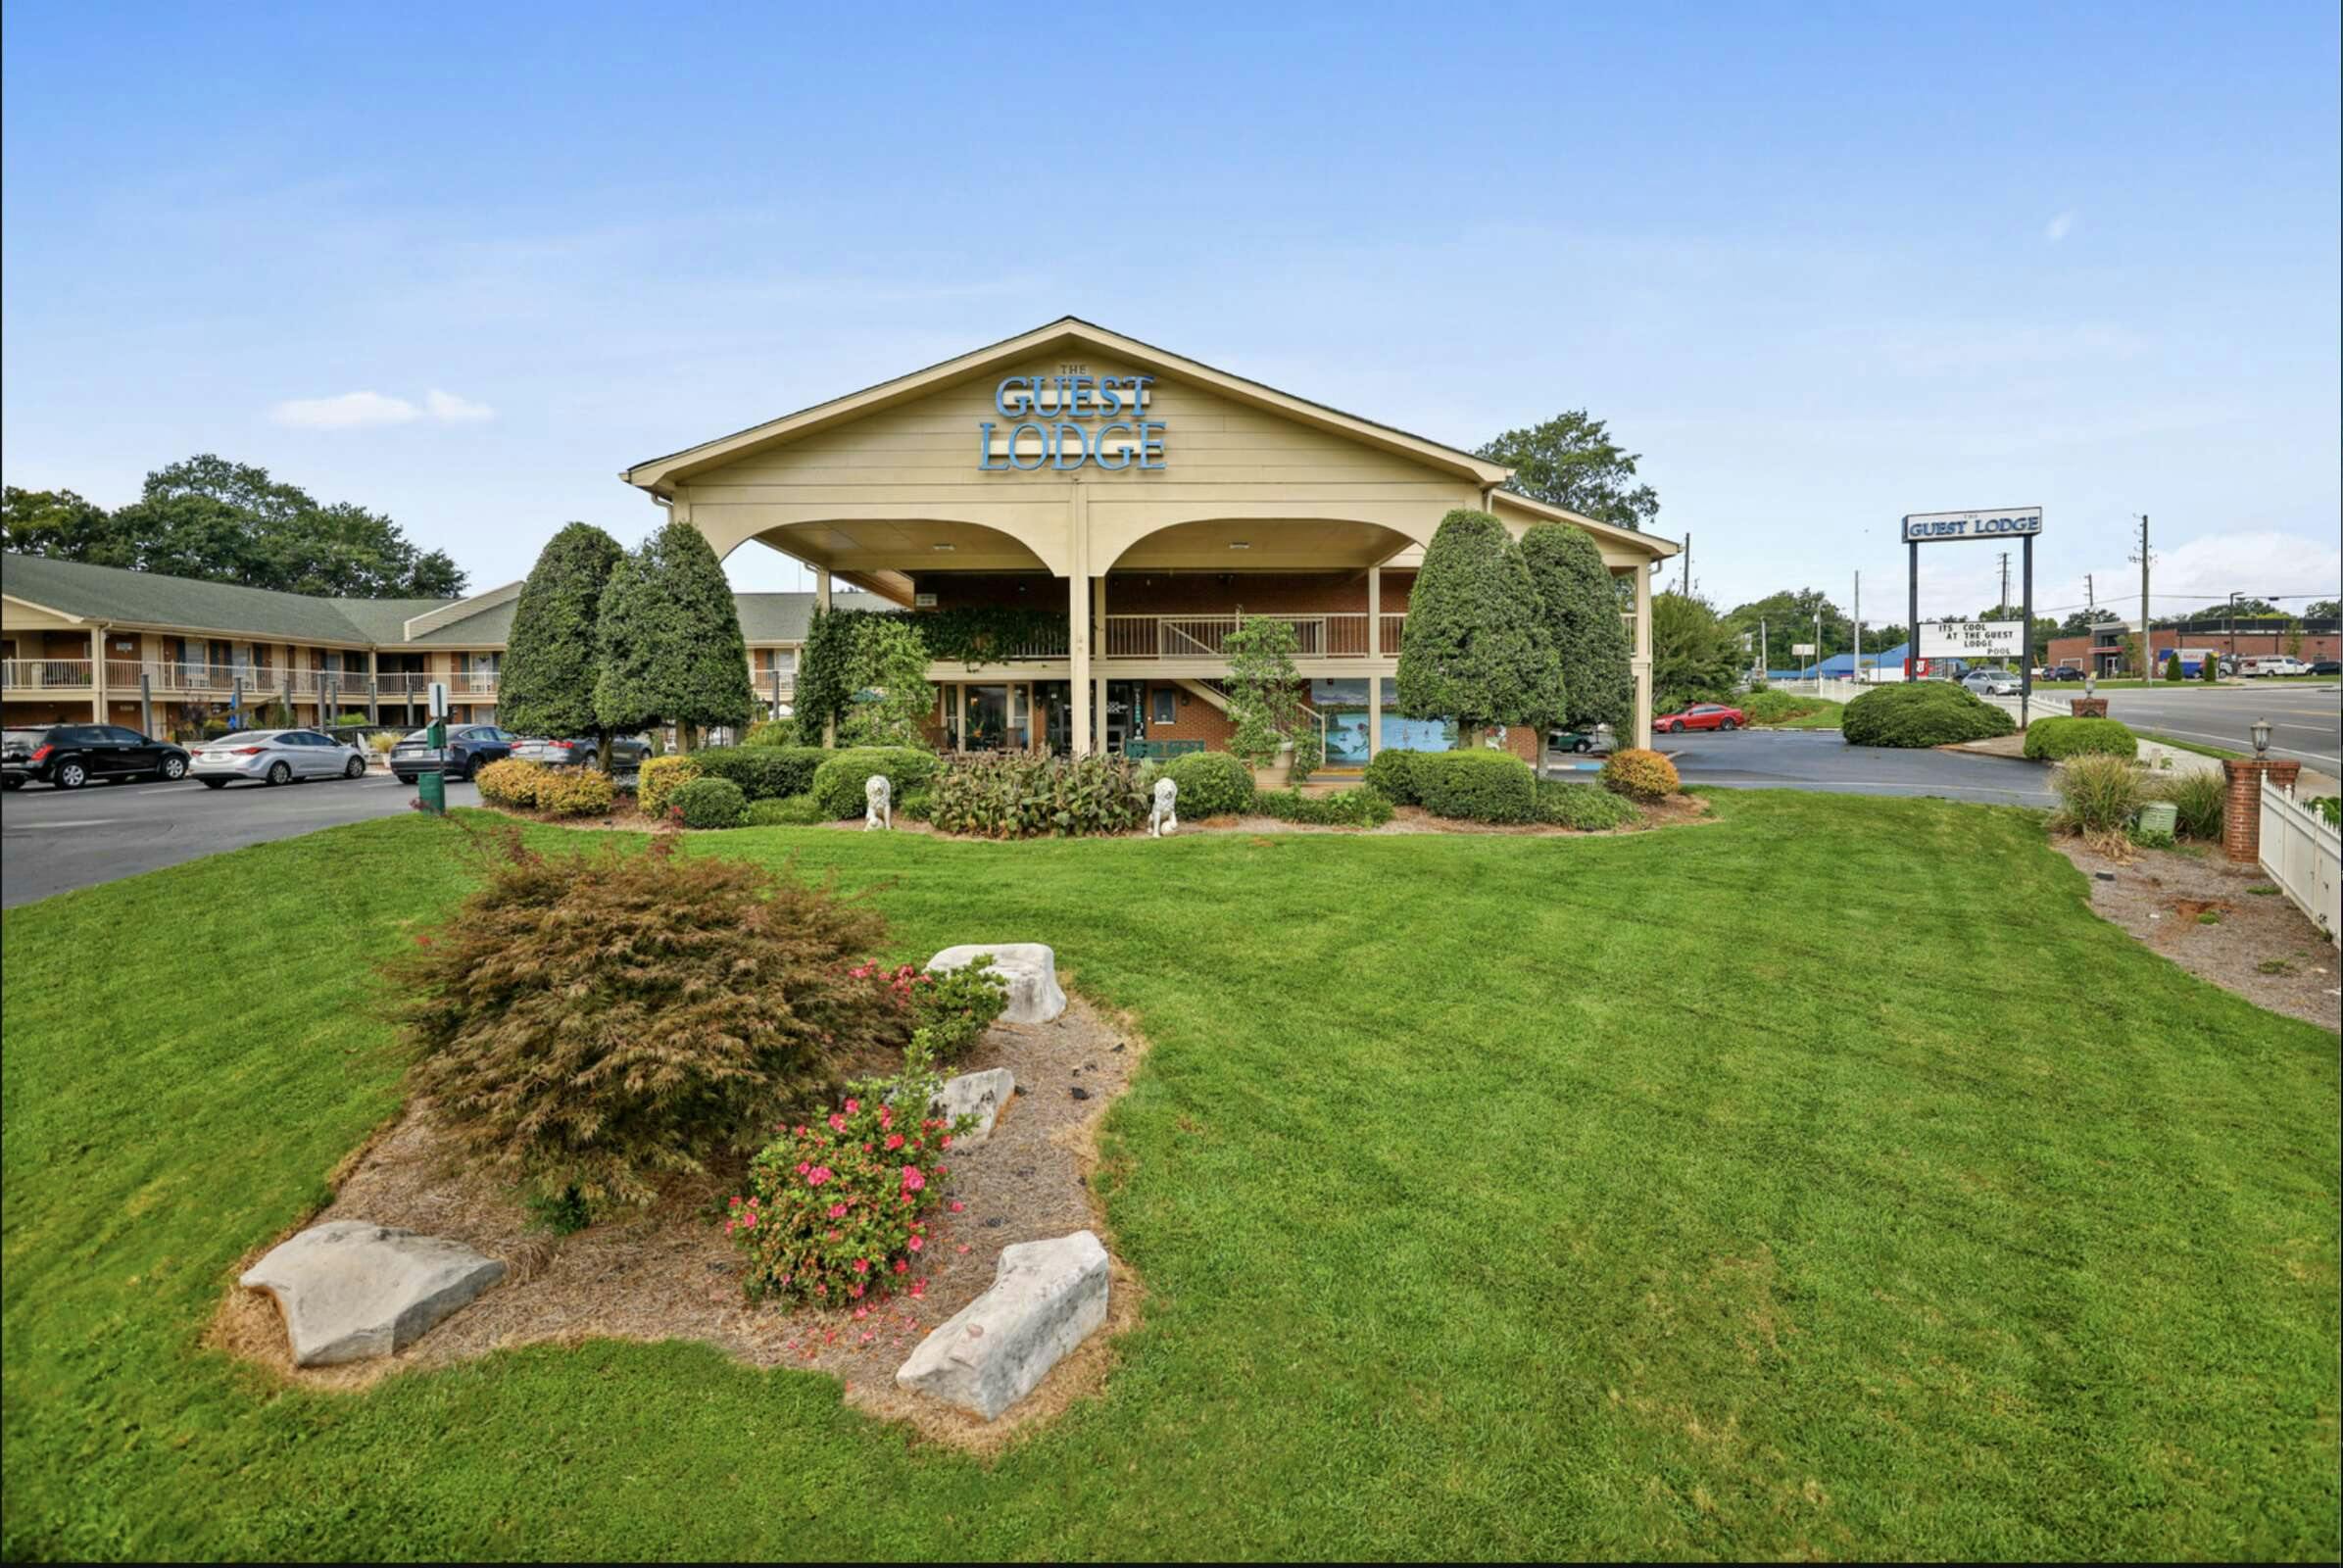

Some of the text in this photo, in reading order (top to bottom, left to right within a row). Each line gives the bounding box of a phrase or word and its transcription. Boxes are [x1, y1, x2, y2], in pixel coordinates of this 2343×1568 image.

[1060, 364, 1087, 374] THE
[996, 375, 1154, 417] GUEST
[978, 422, 1167, 470] LODGE
[1910, 516, 2039, 536] GUEST LODGE
